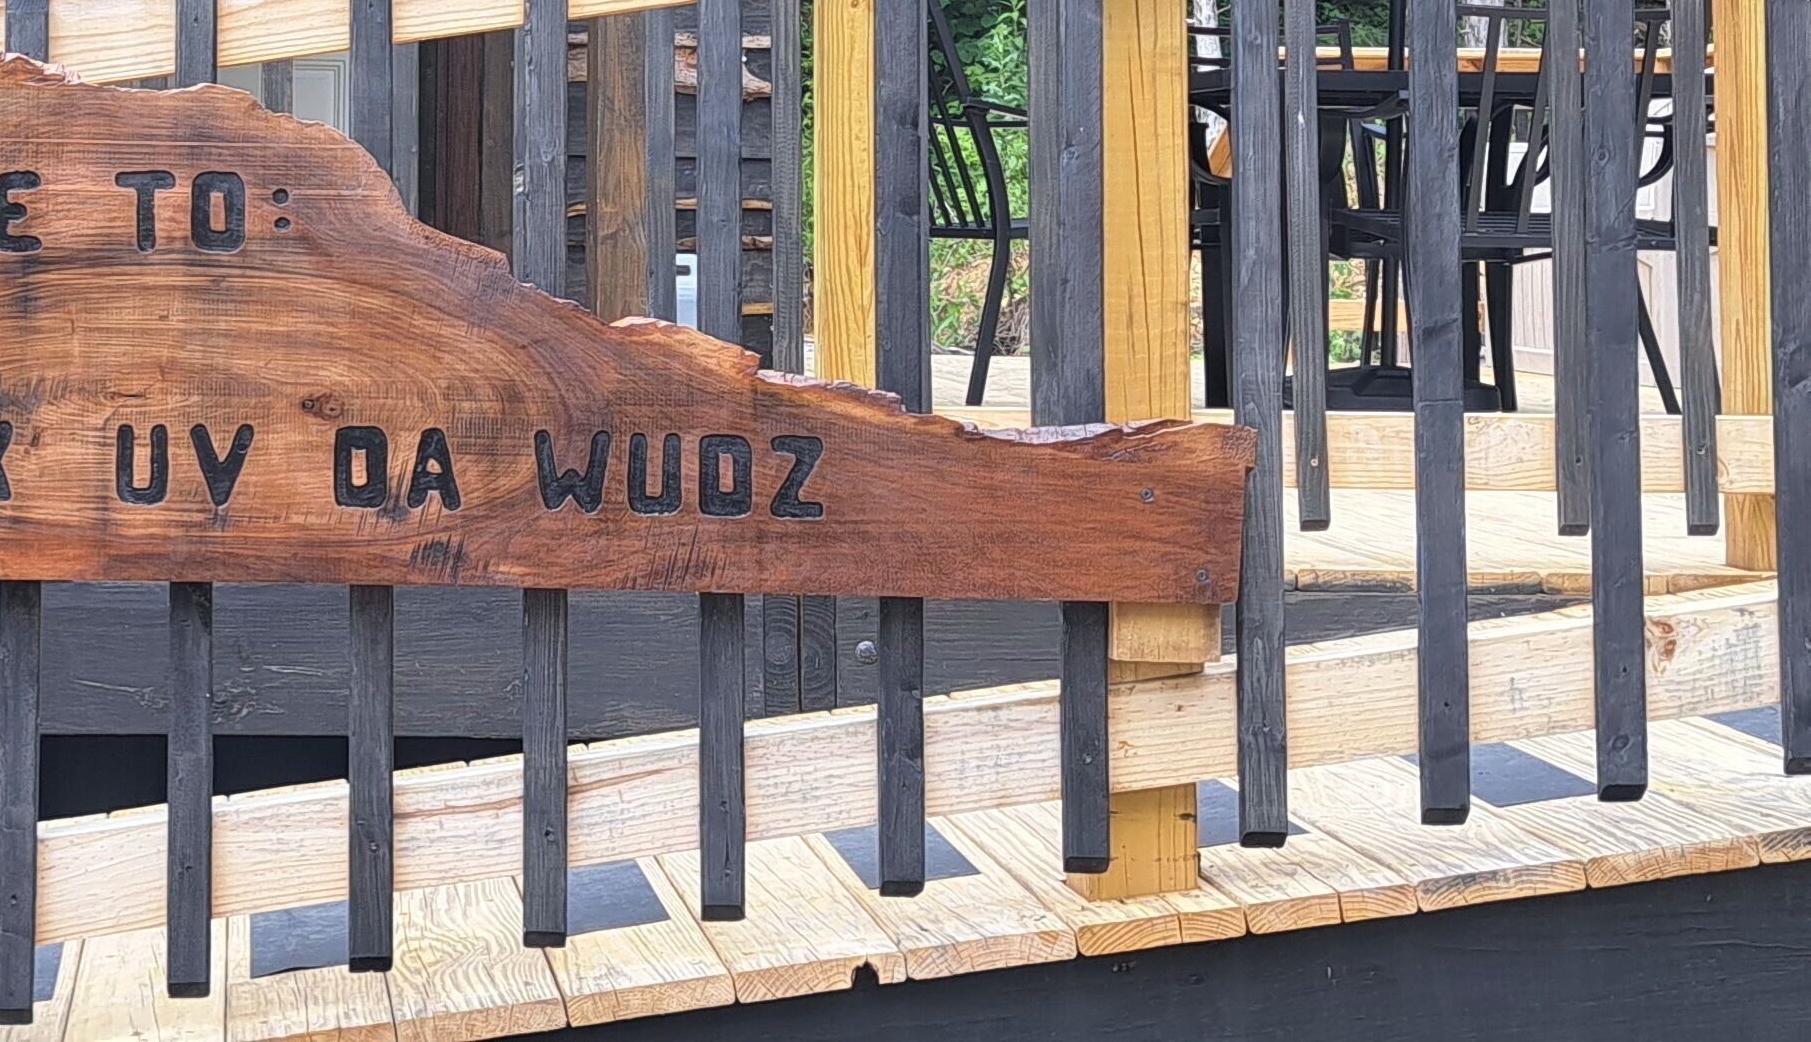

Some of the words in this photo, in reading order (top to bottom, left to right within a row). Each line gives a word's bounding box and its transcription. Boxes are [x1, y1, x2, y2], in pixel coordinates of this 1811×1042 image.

[114, 170, 292, 252] TO:
[115, 423, 256, 508] UV
[333, 425, 462, 512] DA
[533, 429, 825, 519] WUDZ
